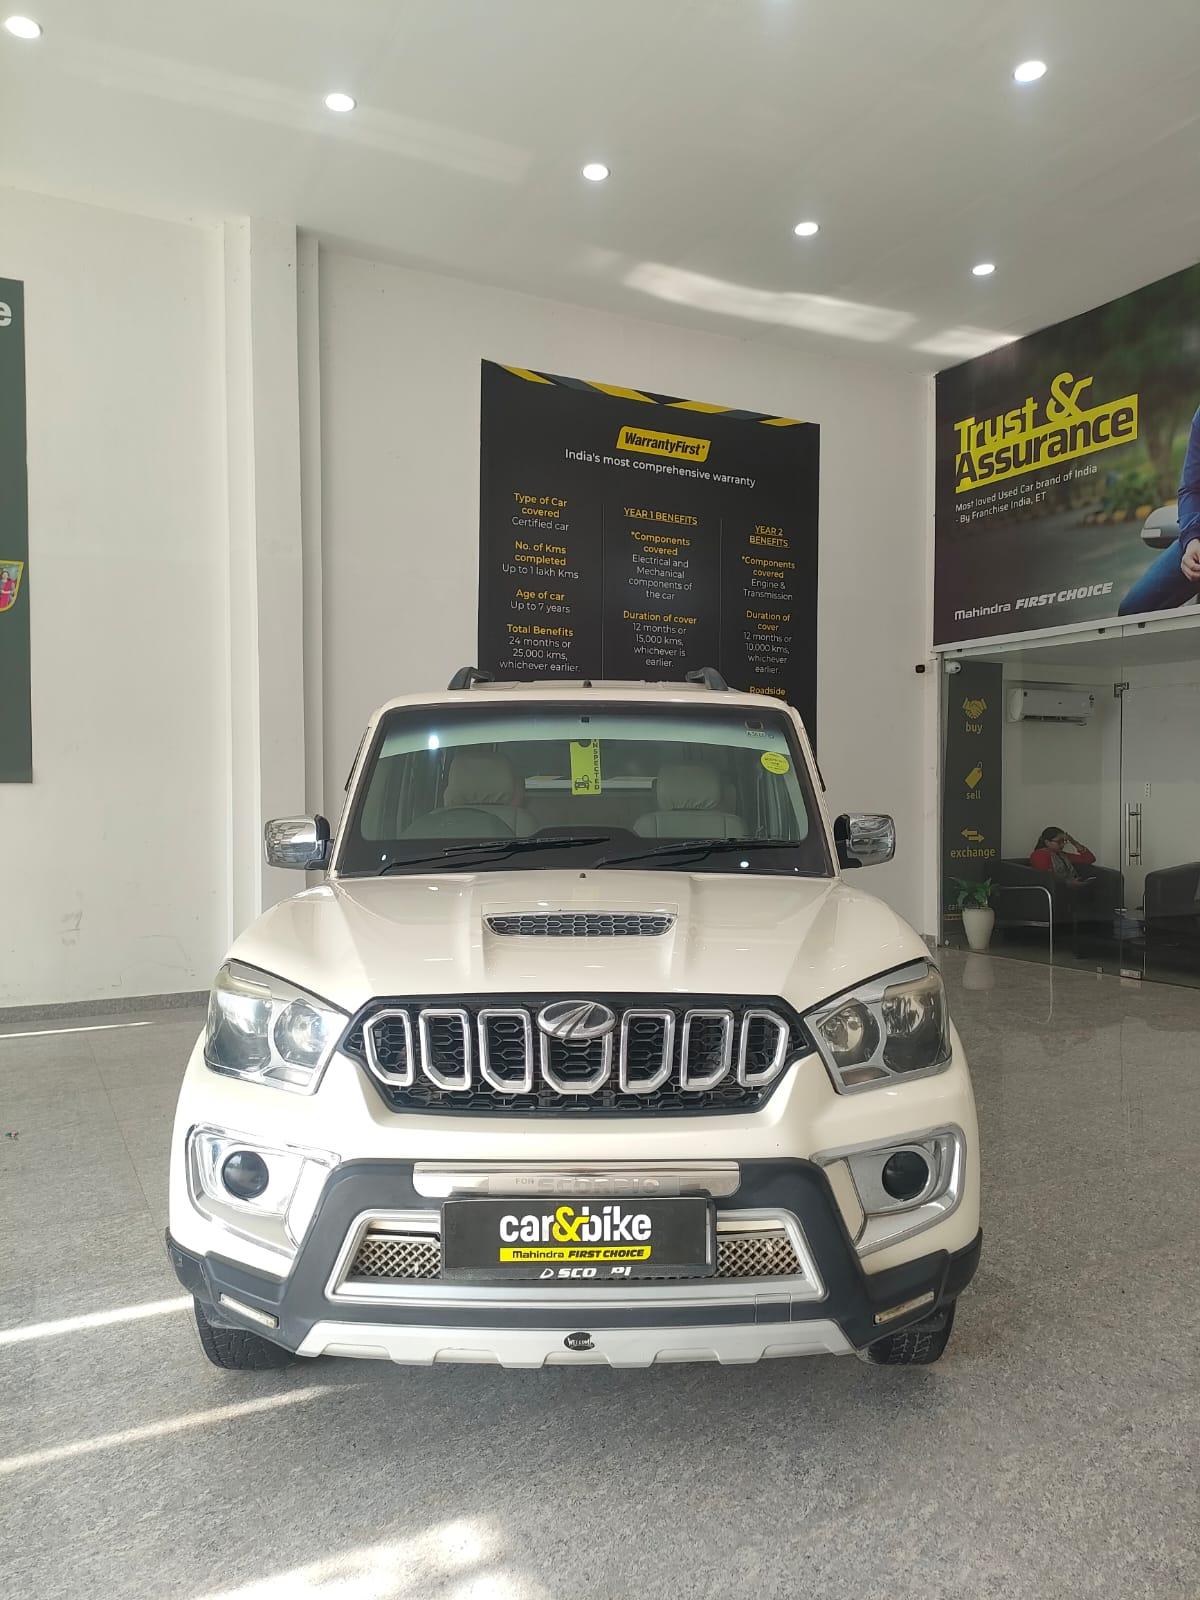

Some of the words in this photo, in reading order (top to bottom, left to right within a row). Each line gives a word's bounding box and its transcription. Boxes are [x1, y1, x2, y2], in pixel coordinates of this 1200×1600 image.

[953, 396, 1038, 453] Trust
[1046, 372, 1094, 422] &
[955, 406, 1135, 484] Assurance
[565, 448, 600, 463] India's
[603, 455, 631, 468] most
[633, 458, 711, 480] comprehensive
[712, 471, 756, 488] warranty
[955, 499, 974, 512] Most
[975, 493, 996, 507] loved
[998, 486, 1018, 500] Used
[1020, 484, 1034, 494] Car
[1036, 475, 1061, 489] brand
[1063, 471, 1073, 482] of
[1075, 464, 1098, 479] India
[513, 492, 536, 504] Type
[539, 496, 550, 504] of
[551, 498, 567, 507] Car
[521, 507, 560, 518] covered
[960, 513, 970, 525] By
[972, 503, 1008, 520] Franchise
[1011, 498, 1033, 511] India,
[1035, 491, 1047, 501] ET
[623, 507, 648, 519] YEAR
[656, 511, 698, 525] BENEFITS
[511, 517, 553, 529] Certified
[554, 523, 569, 531] car
[755, 525, 777, 535] YEAR
[778, 527, 784, 535] 2
[515, 540, 530, 550] No.
[533, 543, 544, 551] of
[545, 545, 566, 554] Kms
[749, 535, 788, 547] BENEFITS
[643, 545, 678, 556] covered
[514, 554, 566, 566] completed
[632, 554, 670, 566] Electrical
[672, 558, 689, 568] and
[502, 563, 516, 574] Up
[518, 566, 528, 574] to
[536, 566, 556, 577] lakh
[558, 569, 579, 579] Kms
[636, 565, 685, 578] Mechanical
[753, 569, 784, 578] covered
[629, 577, 682, 590] components
[684, 582, 692, 590] of
[751, 579, 779, 589] Engine
[516, 589, 535, 599] Age
[550, 593, 565, 601] car
[646, 590, 660, 599] the
[662, 592, 674, 600] car
[743, 589, 793, 600] Transmission
[510, 601, 524, 611] Up
[527, 603, 536, 611] to
[538, 603, 544, 611] 7
[546, 604, 570, 614] years
[954, 601, 1011, 621] Mahindra
[1015, 592, 1056, 610] FIRST
[1057, 582, 1113, 602] CHOICE
[623, 610, 662, 621] Duration
[663, 614, 673, 622] of
[674, 615, 697, 624] cover
[746, 610, 781, 620] Duration
[507, 624, 531, 634] Total
[533, 626, 574, 637] Benefits
[633, 623, 642, 631] 12
[644, 623, 676, 633] months
[757, 623, 779, 631] cover
[509, 636, 521, 645] 24
[523, 637, 560, 648] months
[562, 640, 571, 648] or
[636, 634, 662, 645] 15,000
[664, 636, 684, 646] kms,
[744, 632, 751, 640] 12
[753, 633, 783, 642] months
[546, 651, 568, 661] kms,
[634, 646, 678, 656] whichever
[680, 648, 685, 657] is
[646, 657, 674, 668] earlier.
[748, 654, 788, 663] whichever
[500, 660, 548, 671] whichever
[755, 665, 780, 674] earlier.
[750, 686, 785, 696] Roadside
[966, 721, 983, 734] buy
[966, 790, 981, 799] sell
[950, 848, 996, 859] exchange
[499, 1206, 651, 1243] car&bike
[512, 1250, 564, 1258] Mahindra
[568, 1250, 602, 1258] FIRST
[603, 1249, 644, 1258] CHOICE
